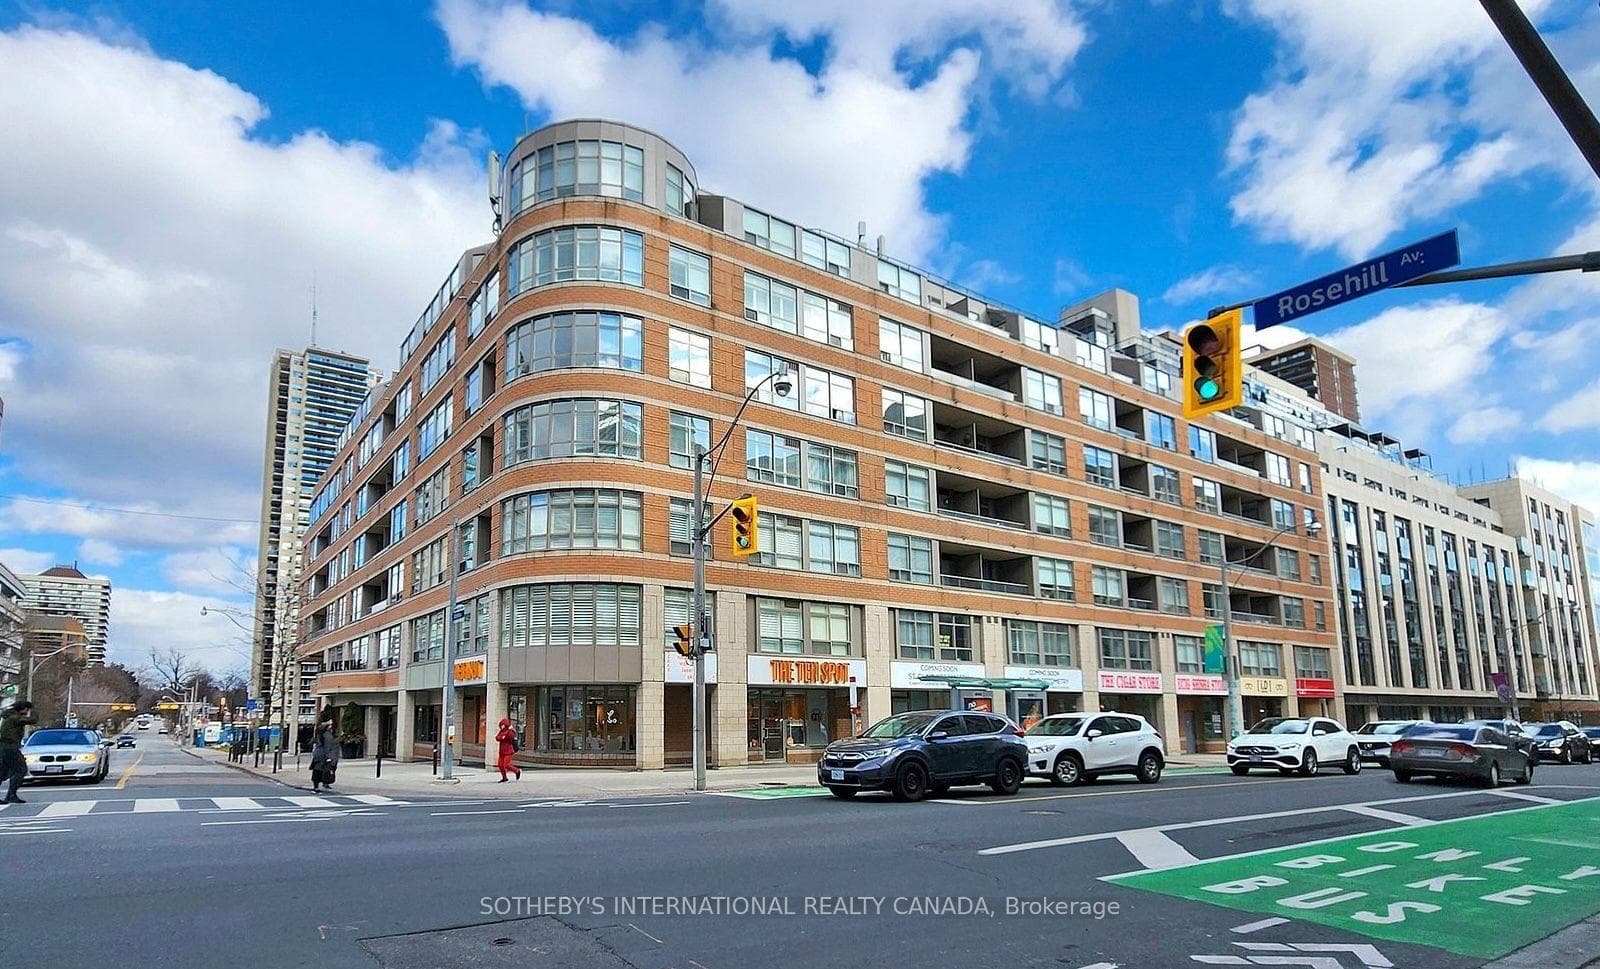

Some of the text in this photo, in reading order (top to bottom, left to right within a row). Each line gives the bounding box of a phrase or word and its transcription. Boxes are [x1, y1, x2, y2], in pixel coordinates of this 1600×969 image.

[1278, 261, 1389, 318] Rosehill
[771, 660, 850, 684] THE TEN SPOT
[921, 664, 942, 672] COMING
[1101, 675, 1160, 689] THE CIGAR STORE
[1274, 855, 1568, 905] BIKE
[1356, 842, 1600, 880] ONLY
[1200, 875, 1442, 924] BUS
